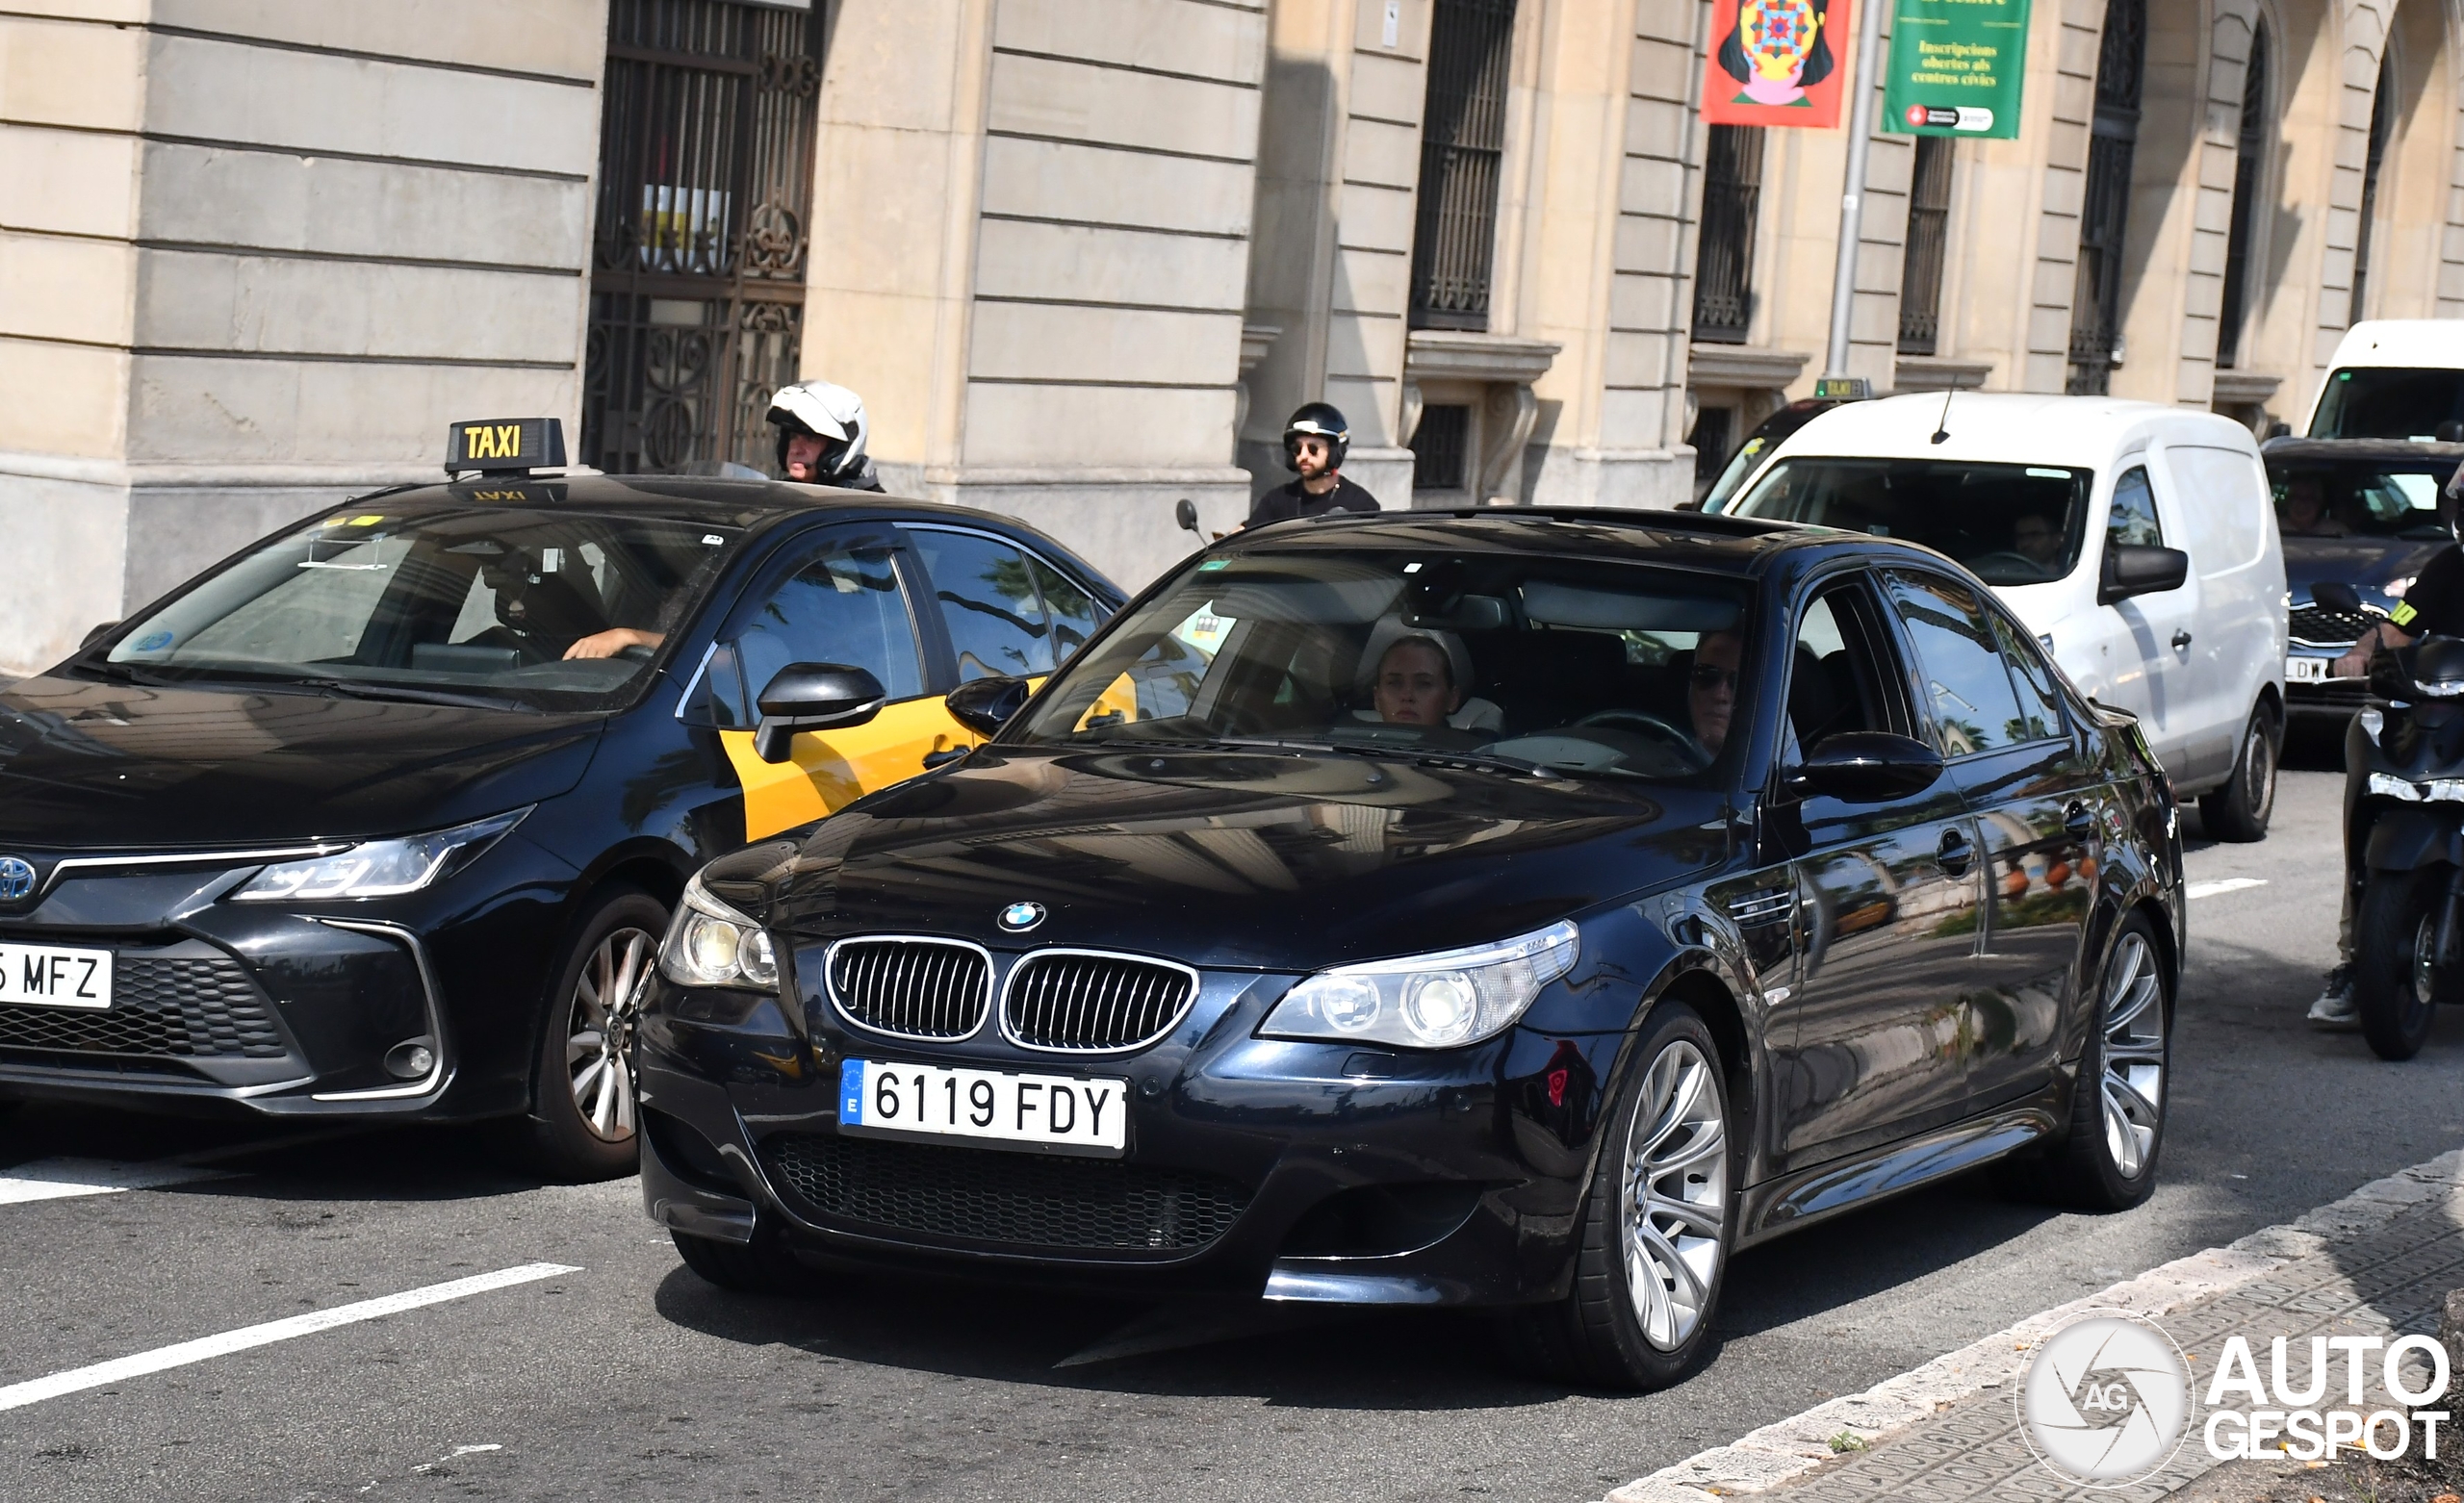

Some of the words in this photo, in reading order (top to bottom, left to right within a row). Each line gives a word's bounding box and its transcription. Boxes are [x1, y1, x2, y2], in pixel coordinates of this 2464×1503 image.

[1918, 40, 1997, 58] Inscripcions
[1921, 55, 1970, 70] obertes
[1971, 58, 1991, 72] als
[1911, 71, 1960, 85] centres
[465, 424, 521, 459] TAXI
[23, 954, 98, 998] MFZ
[847, 1098, 858, 1113] E
[876, 1071, 994, 1128] 6119
[1016, 1083, 1111, 1136] FDY
